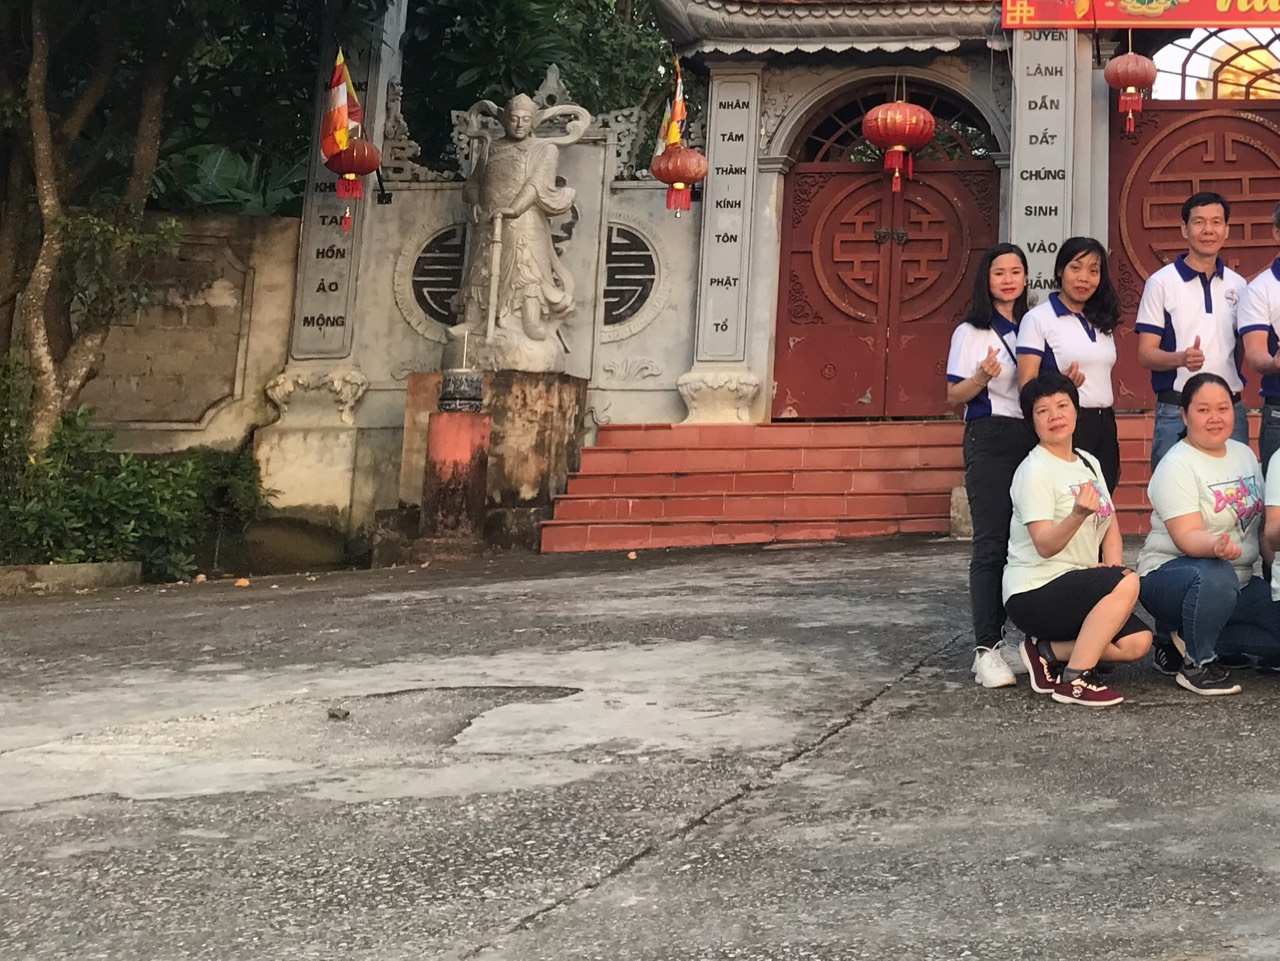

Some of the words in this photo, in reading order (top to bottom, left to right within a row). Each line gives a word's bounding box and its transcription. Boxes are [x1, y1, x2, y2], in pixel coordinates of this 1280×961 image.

[1026, 63, 1063, 77] LÀNH
[718, 98, 750, 110] NHÂN
[720, 131, 744, 142] TÂM
[1029, 127, 1058, 146] DẮT
[714, 164, 747, 176] THÀNH
[1019, 167, 1066, 181] CHÚNG
[715, 198, 742, 209] KÍNH
[1024, 205, 1058, 217] SINH
[715, 232, 738, 244] TÔN
[1026, 239, 1058, 254] VÀO
[709, 275, 739, 290] PHẬT
[713, 318, 729, 333] TỔ
